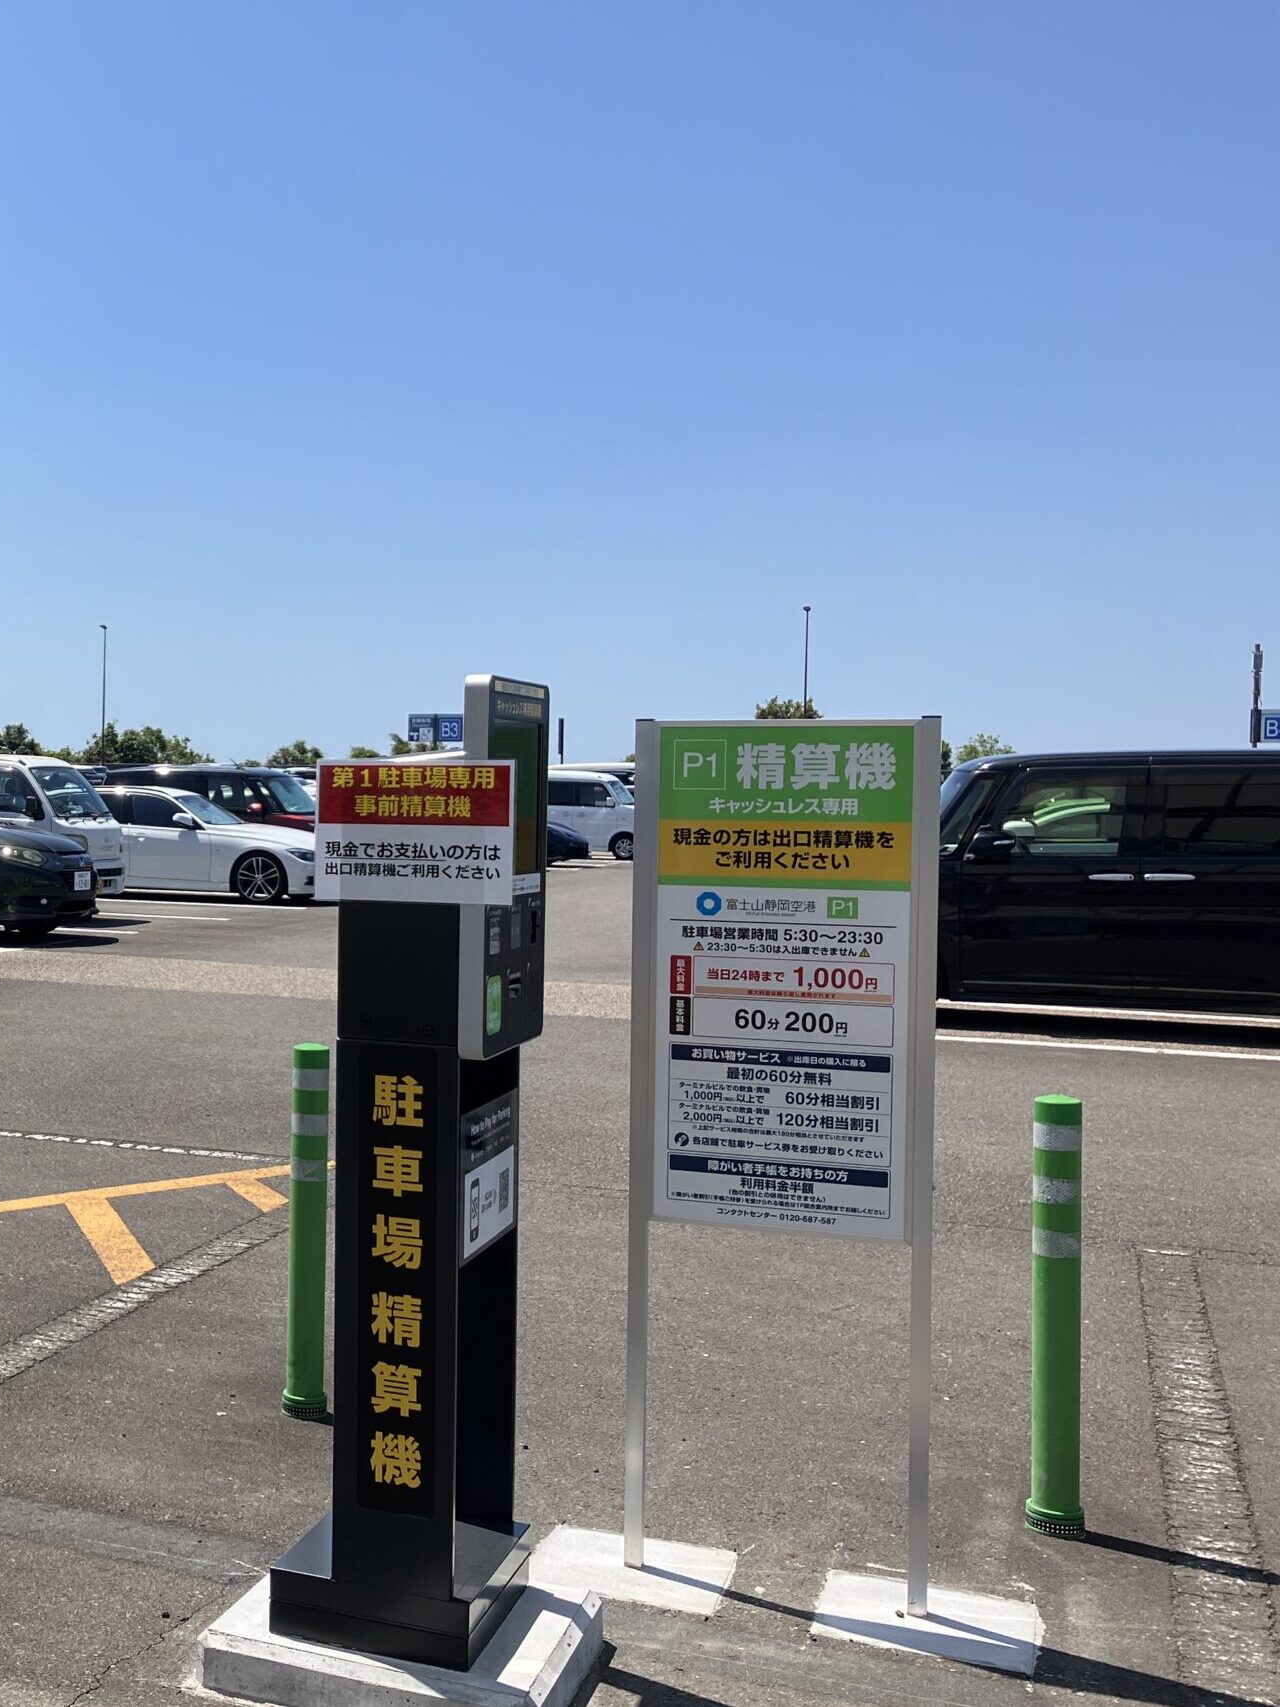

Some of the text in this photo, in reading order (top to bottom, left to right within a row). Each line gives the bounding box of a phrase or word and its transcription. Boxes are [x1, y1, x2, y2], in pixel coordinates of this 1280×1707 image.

[441, 722, 458, 738] B3
[1266, 719, 1280, 737] B
[683, 742, 897, 791] P1 精算機
[332, 766, 495, 789] 第1駐車場専用
[355, 795, 472, 818] 事前精算機
[709, 797, 858, 816] キャッシュレス専用
[673, 828, 894, 849] 現金の方は出口精算機を
[325, 841, 501, 861] 現金でお支払いの方は
[715, 851, 849, 870] ご利用ください
[325, 862, 500, 880] 出口精算機ご利用ください
[726, 898, 816, 913] 富士山静岡空港
[832, 900, 854, 916] P1
[681, 925, 778, 942] 駐車場営業時間
[707, 966, 878, 991] 当日24時まで 1,000円
[676, 999, 686, 1032] 基本料金
[734, 1008, 848, 1035] 60分 200円
[691, 1048, 781, 1064] お買い物サービス
[726, 1066, 832, 1086] 最初の60分無料
[785, 1091, 880, 1111] 60分相当割引
[776, 1113, 879, 1133] 120分相当割引
[692, 1135, 883, 1159] 各店舗で駐車サービス券をお受け取りください
[707, 1159, 848, 1182] 障がい者手帳をお持ちの方
[740, 1177, 814, 1195] 利用料金半額
[716, 1207, 837, 1225] コンタクトセンター 0120-687-587
[371, 1074, 424, 1489] 駐車場精算機
